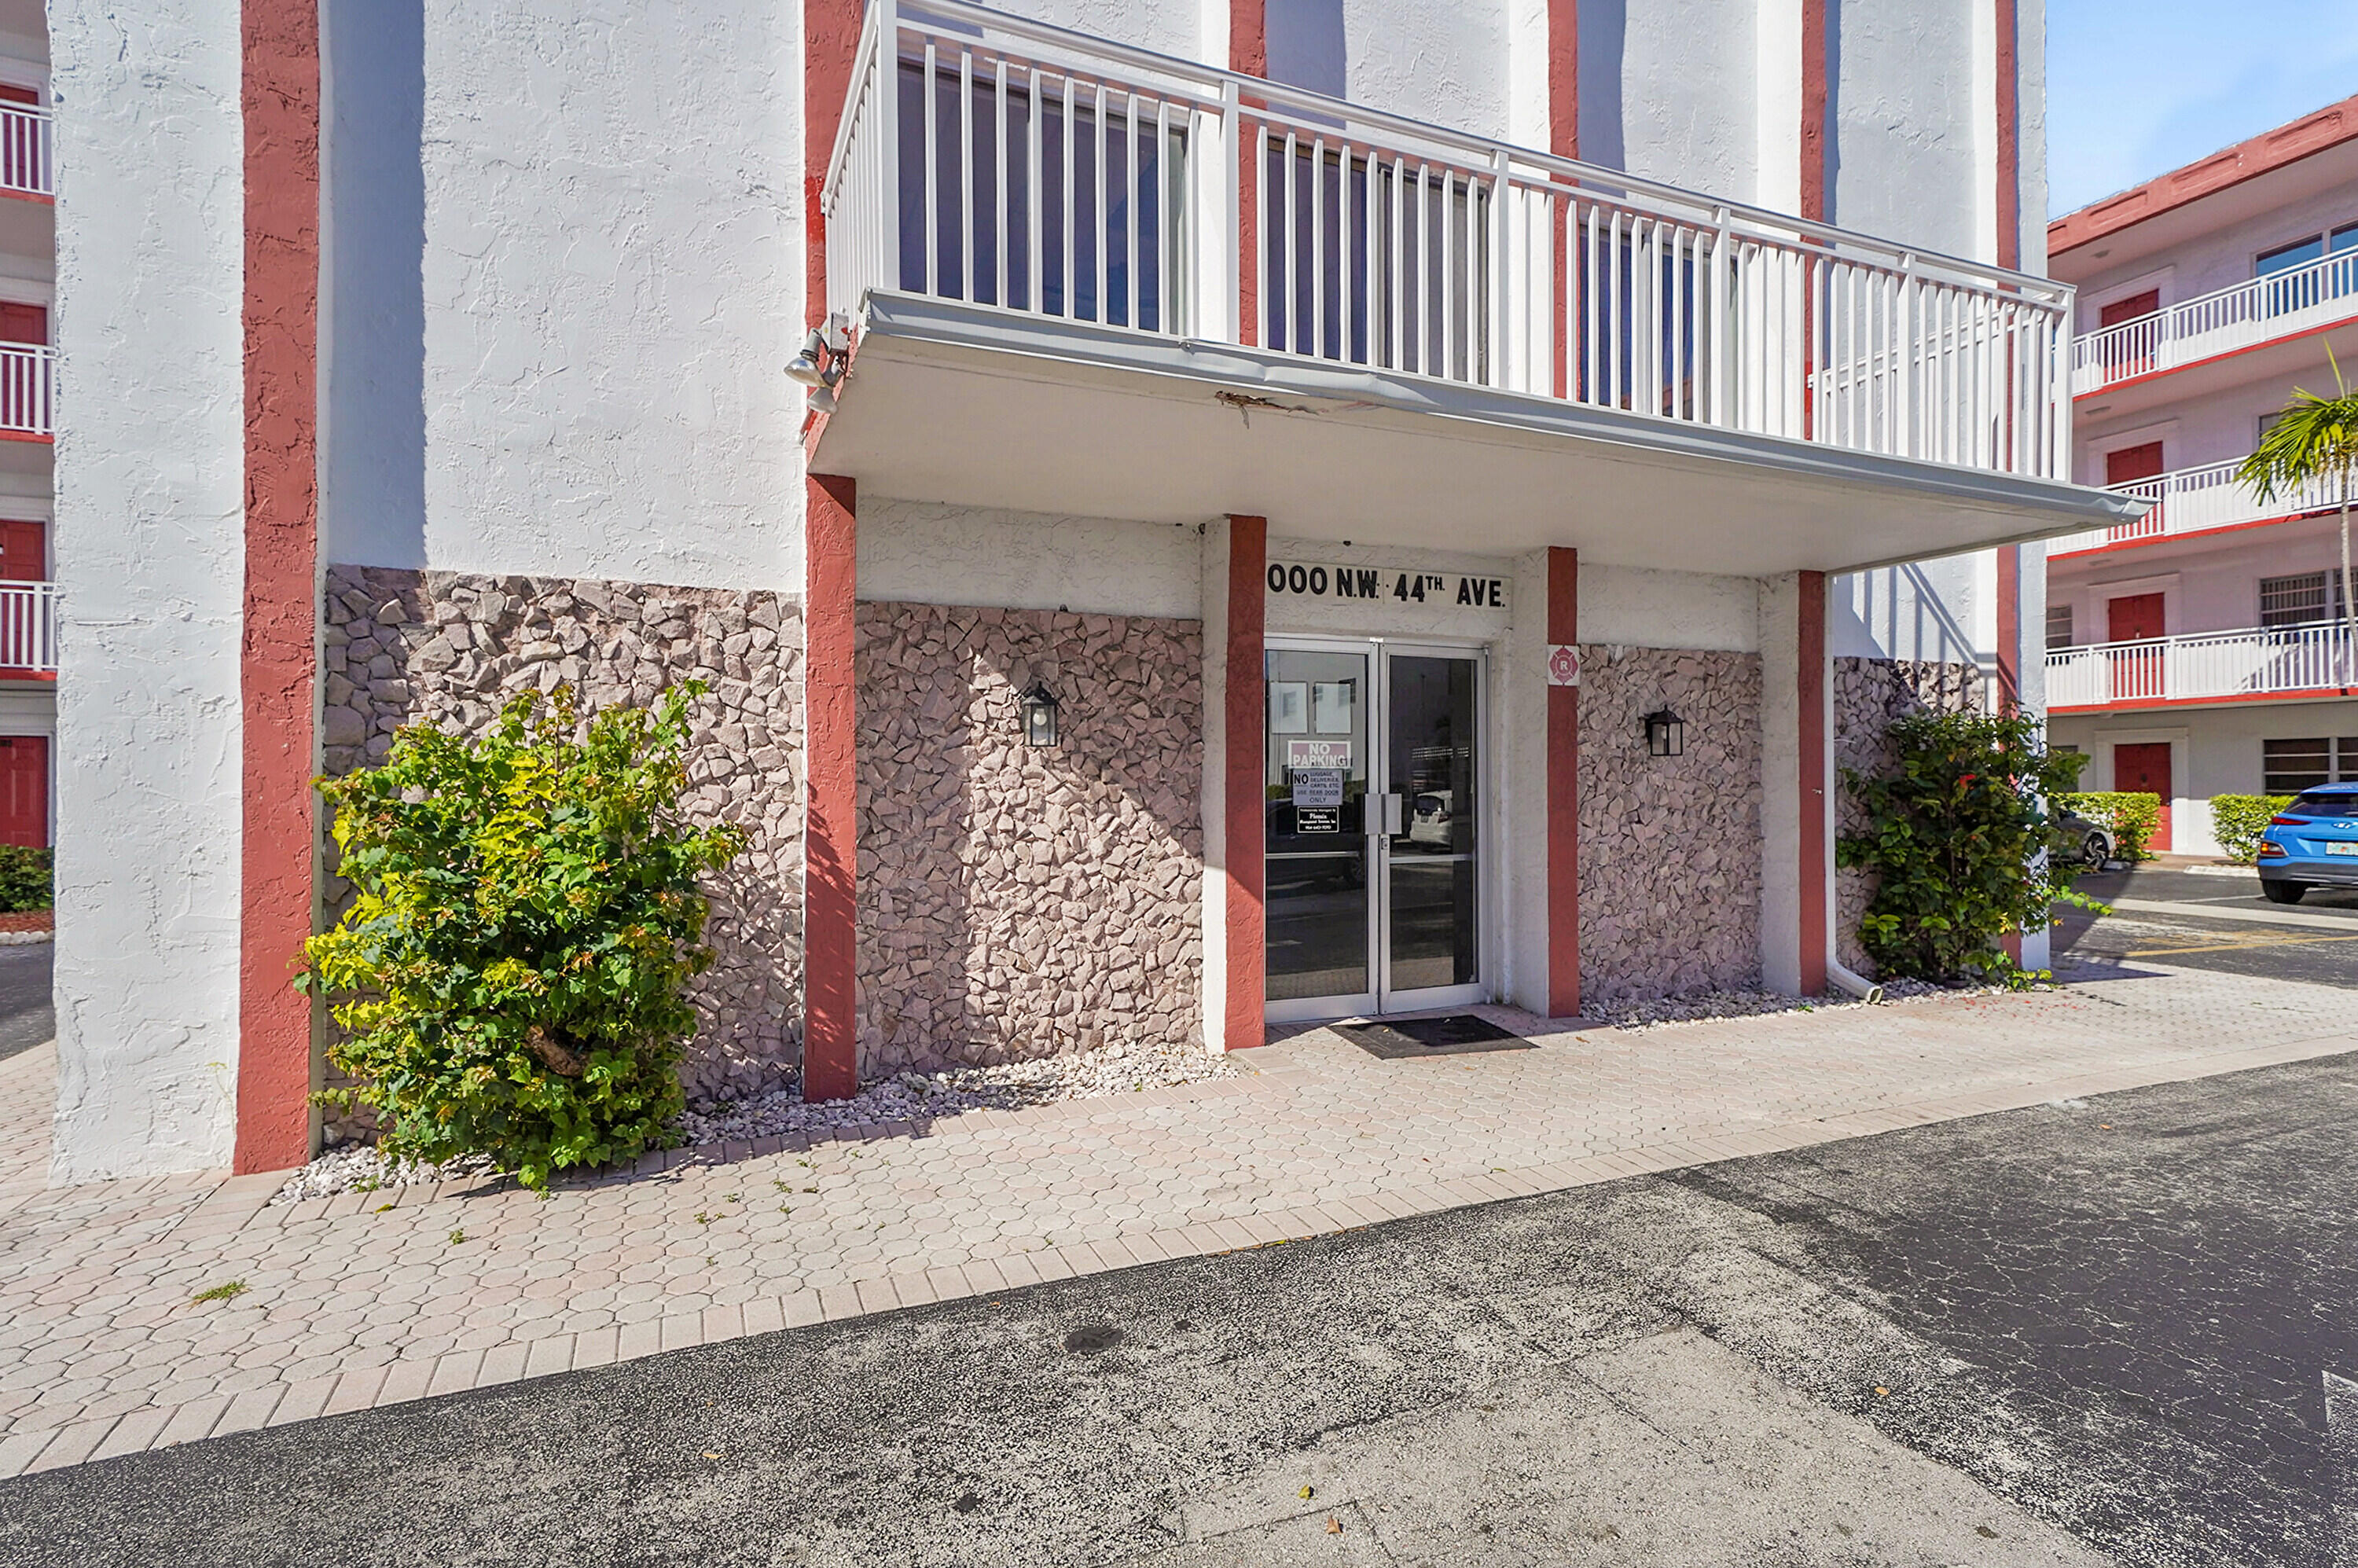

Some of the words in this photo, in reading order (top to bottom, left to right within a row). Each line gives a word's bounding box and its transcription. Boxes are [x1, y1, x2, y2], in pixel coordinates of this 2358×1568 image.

[1336, 567, 1380, 599] N.W.
[1456, 578, 1506, 608] AVE.
[1560, 661, 1568, 670] R
[1308, 744, 1331, 755] NO
[1293, 755, 1346, 767] PARKING
[1294, 773, 1309, 784] NO
